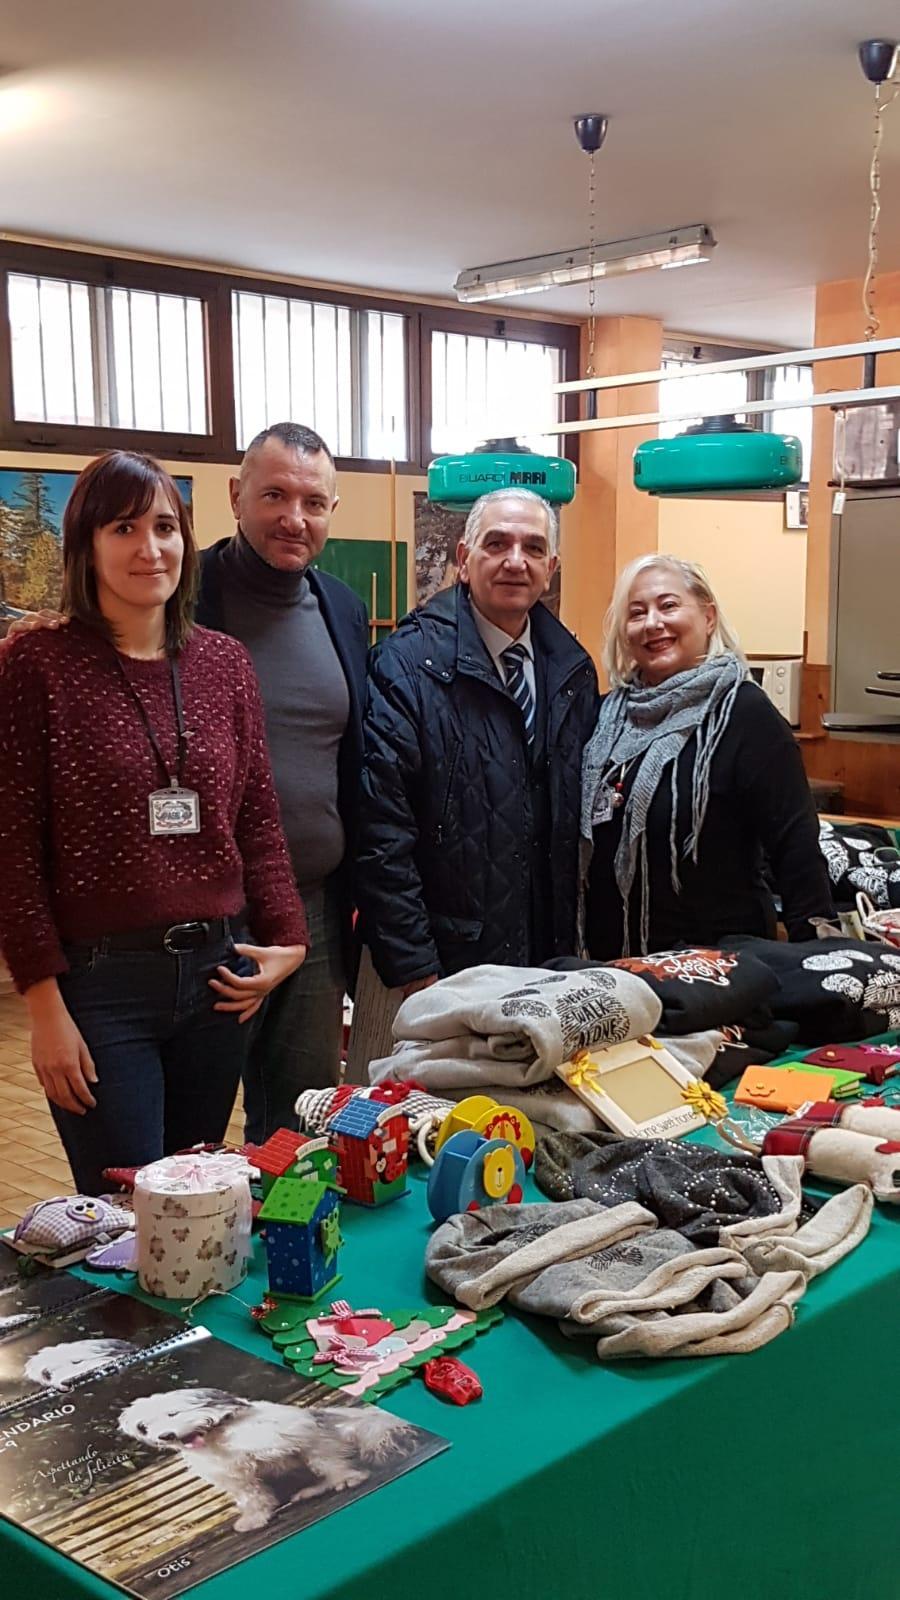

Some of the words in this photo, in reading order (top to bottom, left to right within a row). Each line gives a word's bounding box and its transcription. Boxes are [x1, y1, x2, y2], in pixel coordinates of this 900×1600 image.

[571, 998, 610, 1023] WALK
[576, 1018, 616, 1048] ALONE
[157, 1558, 191, 1578] Otis
